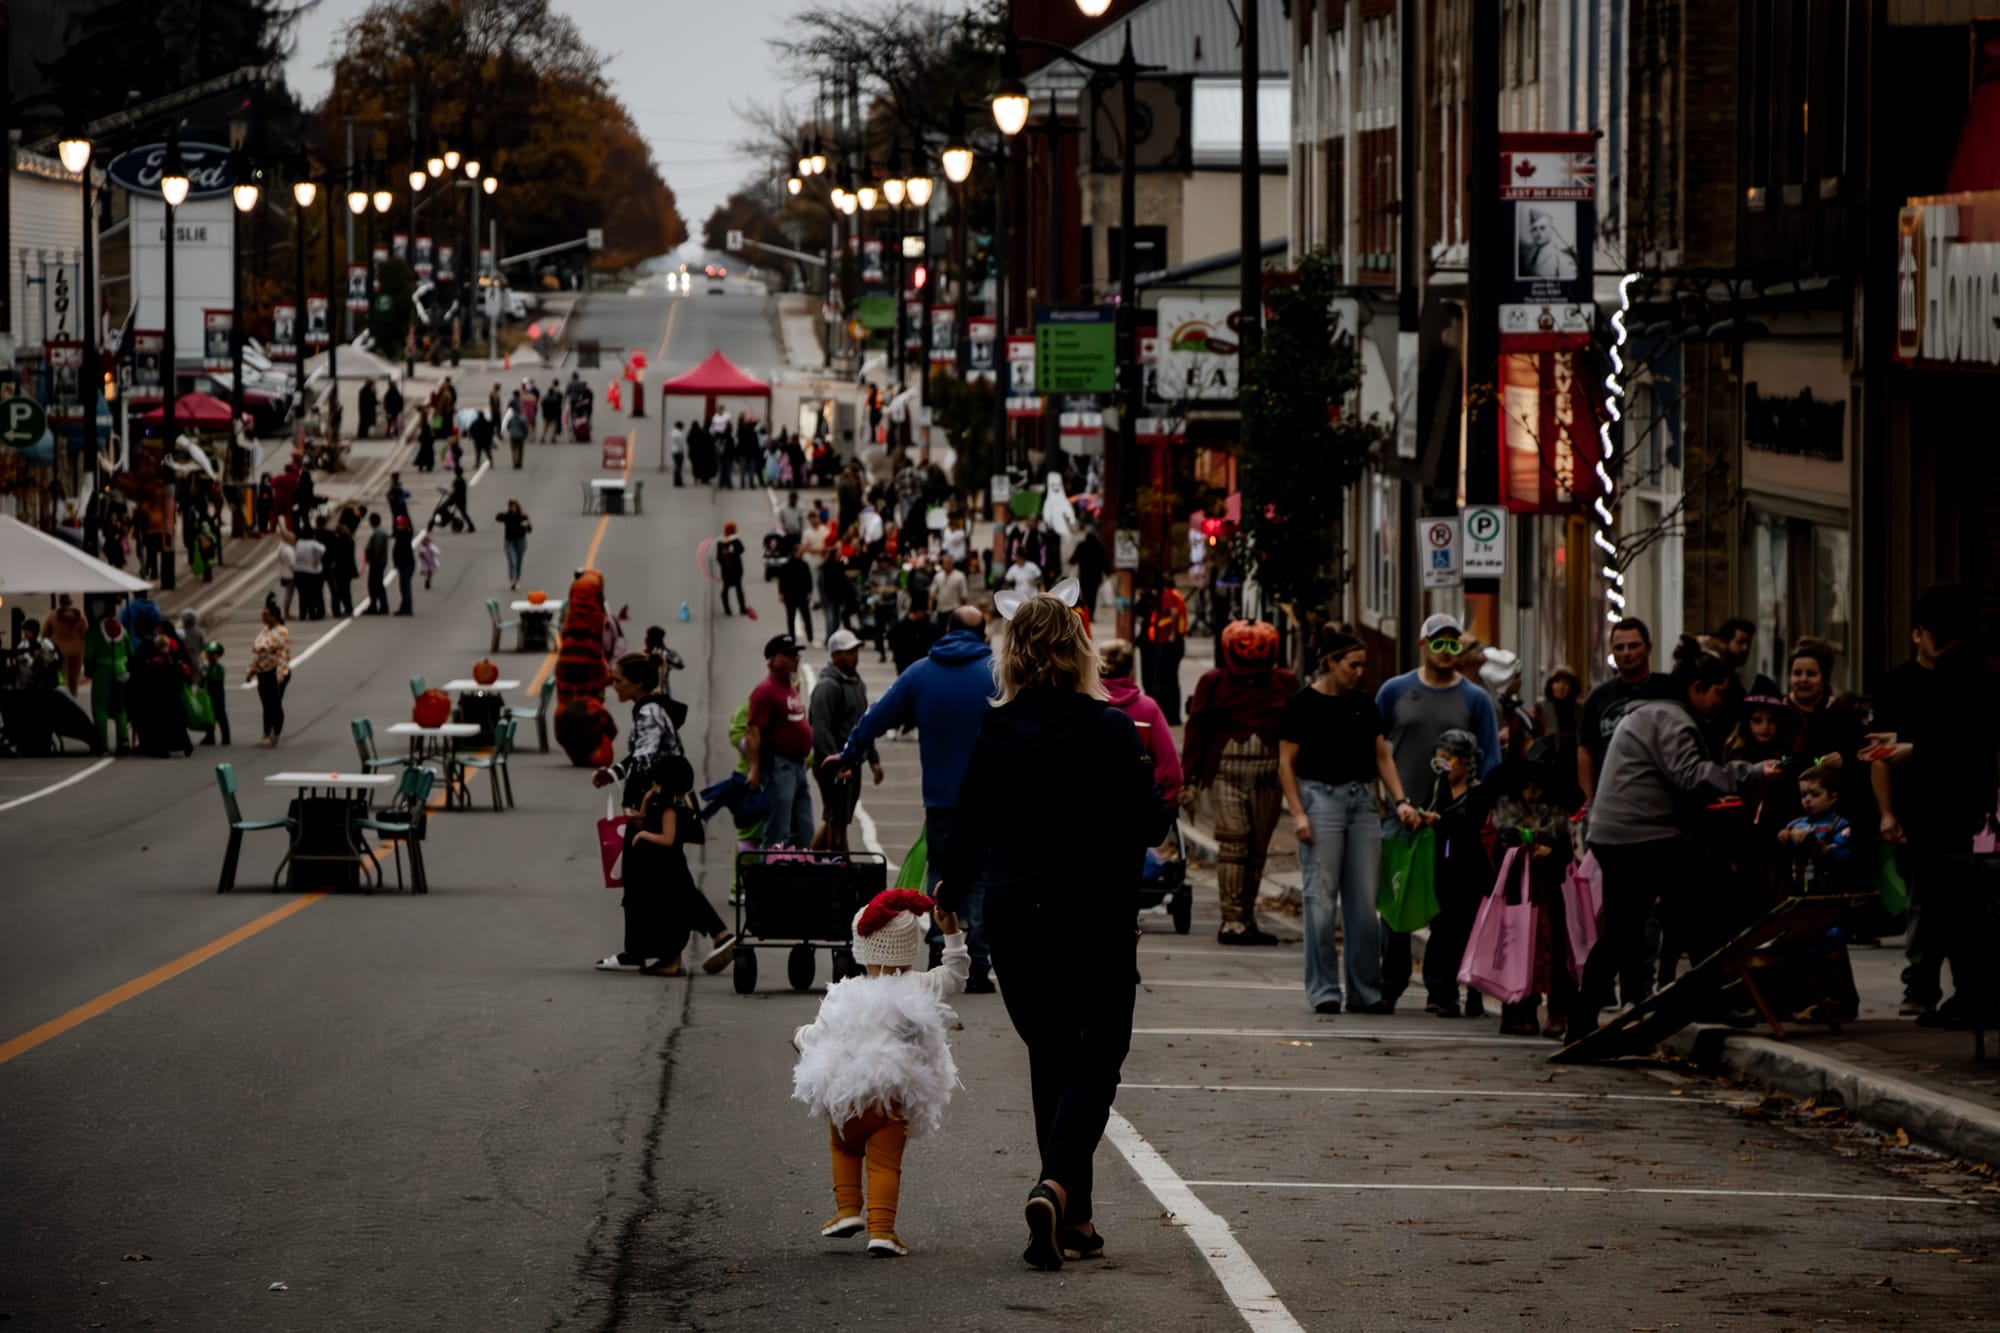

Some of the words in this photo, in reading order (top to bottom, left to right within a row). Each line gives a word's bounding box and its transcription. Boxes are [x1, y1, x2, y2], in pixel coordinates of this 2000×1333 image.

[137, 149, 227, 187] Frd
[1550, 188, 1589, 198] FORGET
[160, 227, 207, 241] LSLIE
[10, 402, 32, 430] P
[1478, 517, 1491, 533] P
